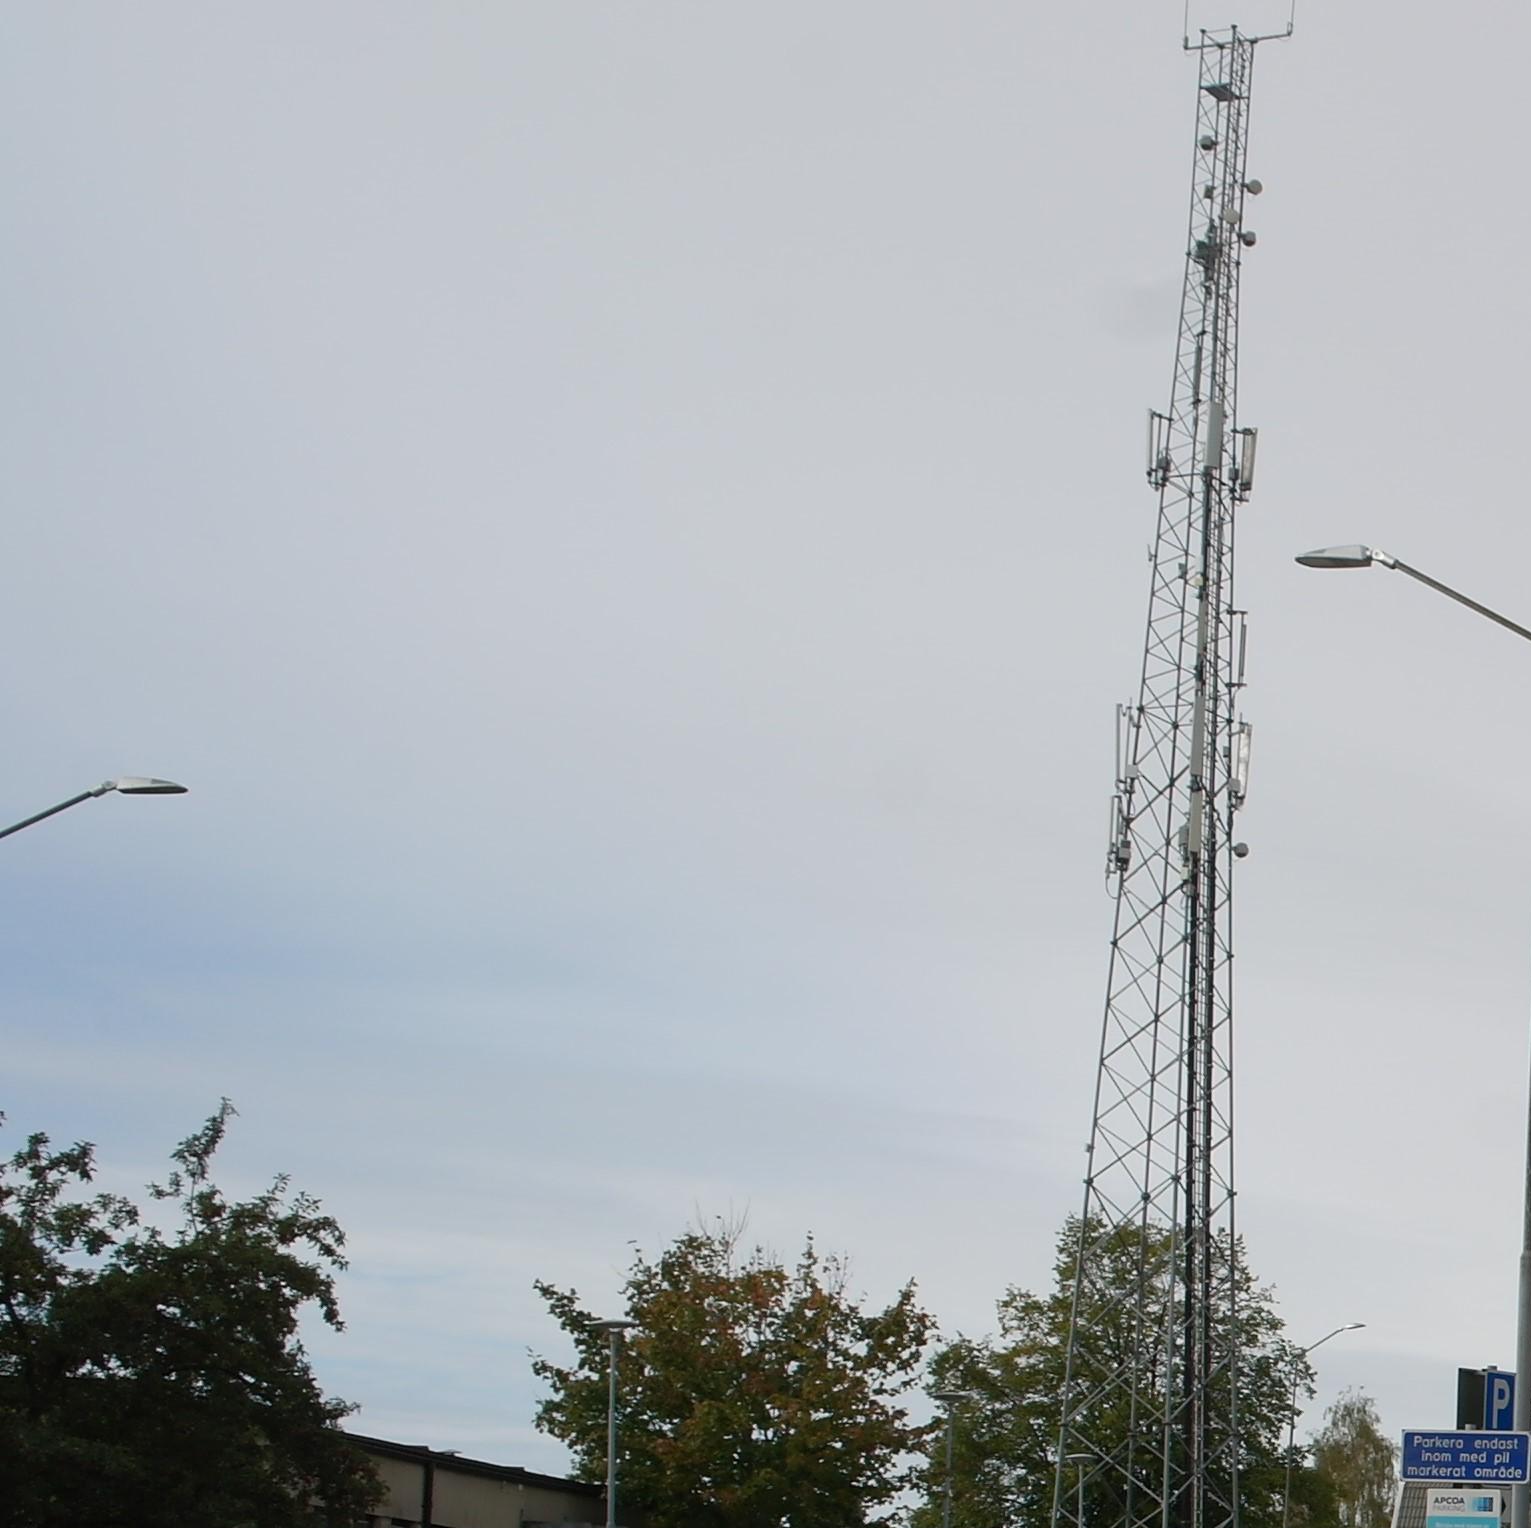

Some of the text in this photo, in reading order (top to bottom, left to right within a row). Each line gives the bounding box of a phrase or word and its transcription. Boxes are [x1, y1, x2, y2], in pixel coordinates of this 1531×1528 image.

[1492, 1378, 1510, 1429] P
[1413, 1436, 1519, 1449] Parkera endast
[1421, 1450, 1510, 1466] inom med pil
[1407, 1465, 1522, 1478] markerat område
[1434, 1497, 1465, 1505] APCOA
